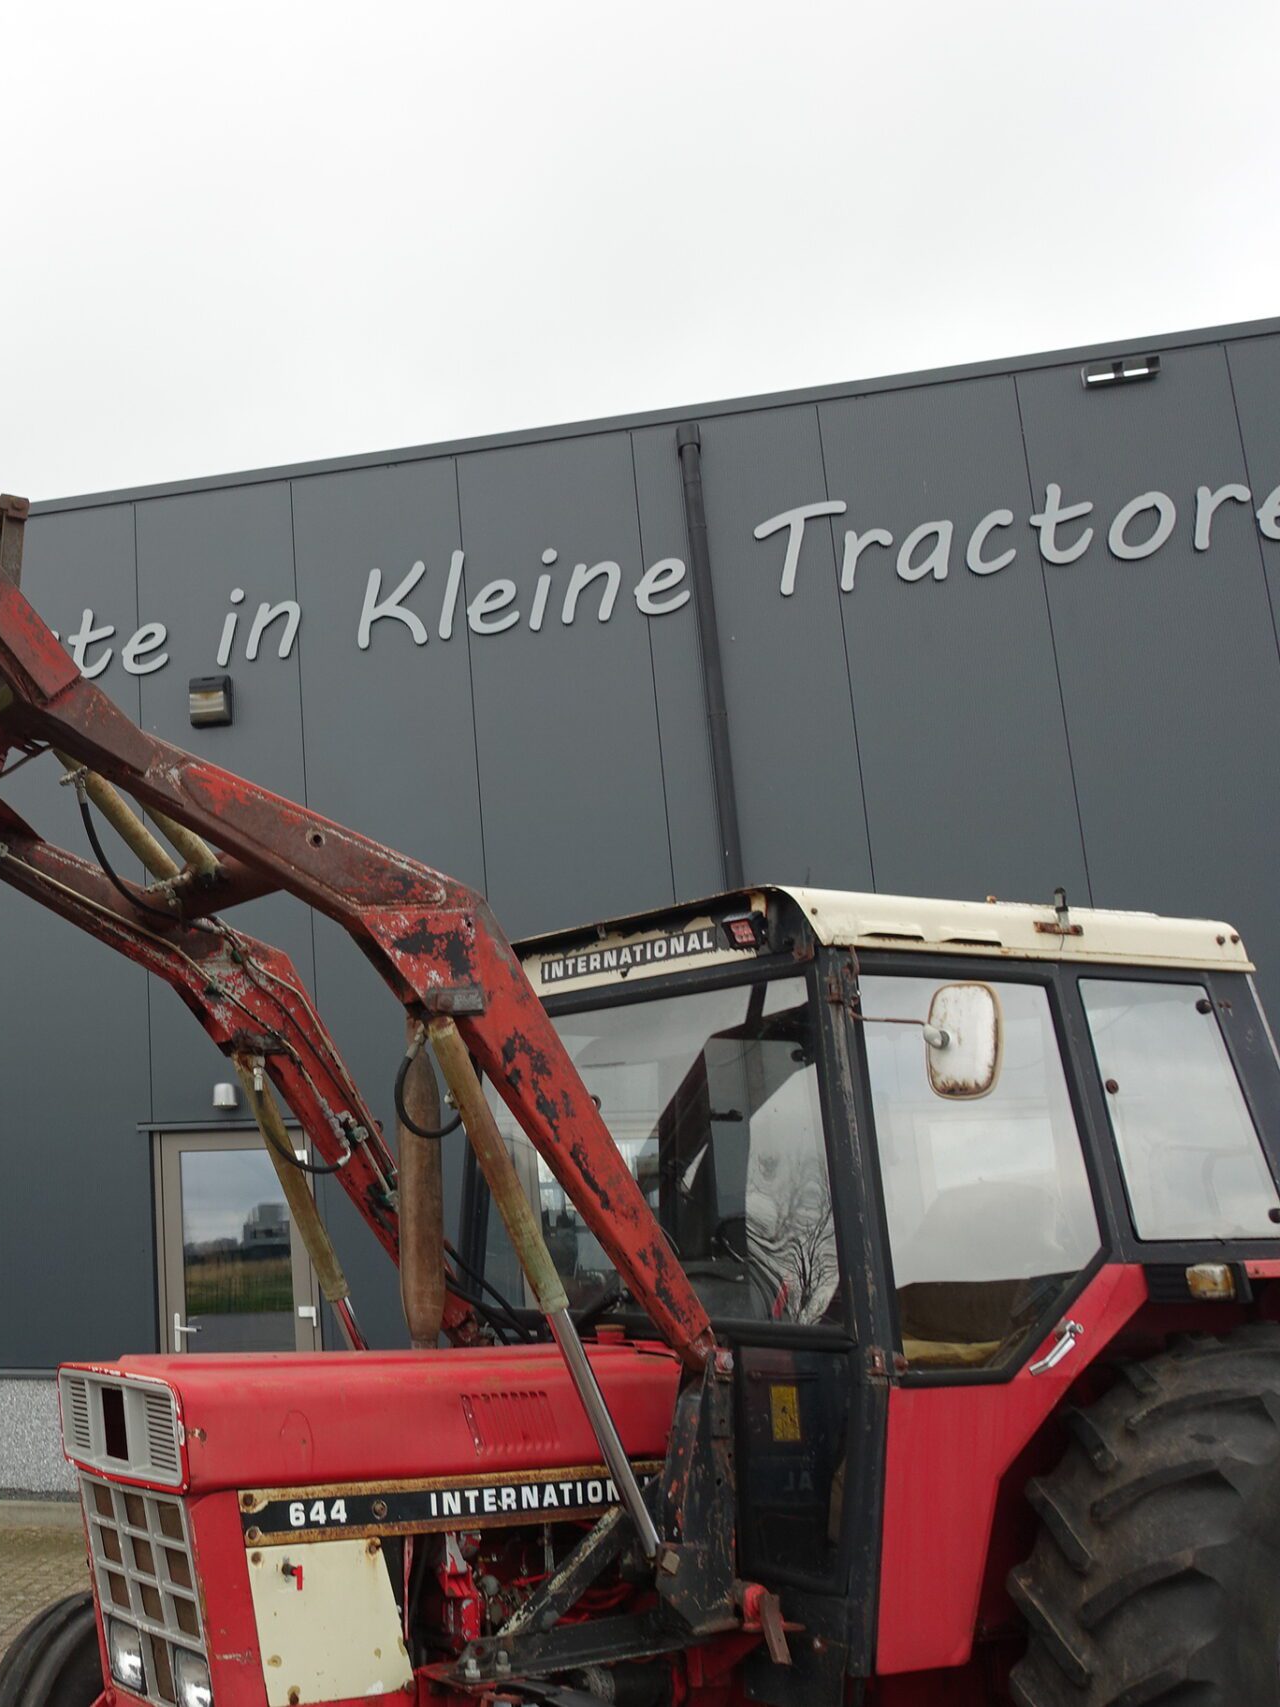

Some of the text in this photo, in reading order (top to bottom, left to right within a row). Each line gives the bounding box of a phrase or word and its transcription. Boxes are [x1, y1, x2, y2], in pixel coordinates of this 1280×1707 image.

[216, 587, 301, 667] in
[357, 547, 691, 650] Kleine
[543, 930, 714, 981] INTERNATIONAL
[289, 1475, 650, 1528] 644 INTERNATION
